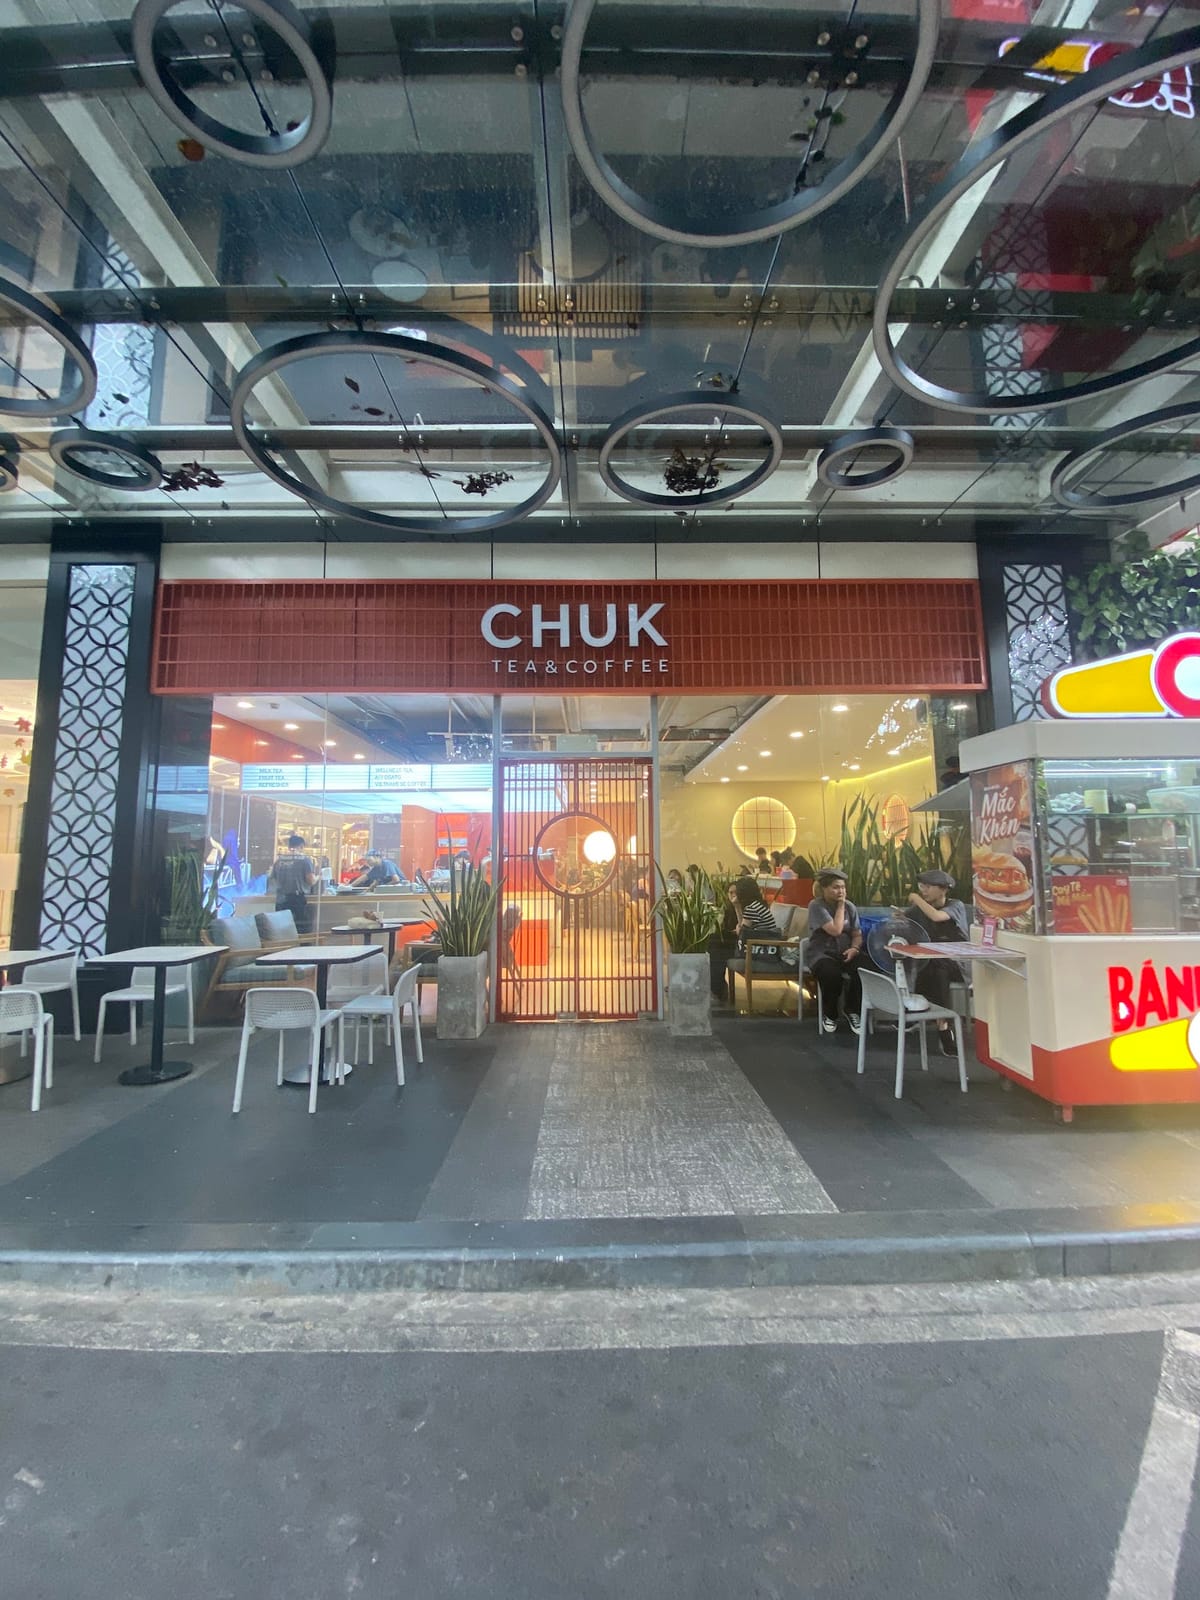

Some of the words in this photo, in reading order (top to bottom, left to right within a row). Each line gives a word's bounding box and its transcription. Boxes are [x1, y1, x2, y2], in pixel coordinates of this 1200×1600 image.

[480, 603, 669, 649] CHUK
[980, 786, 1016, 818] Mắc
[1107, 959, 1200, 1033] BÁN
